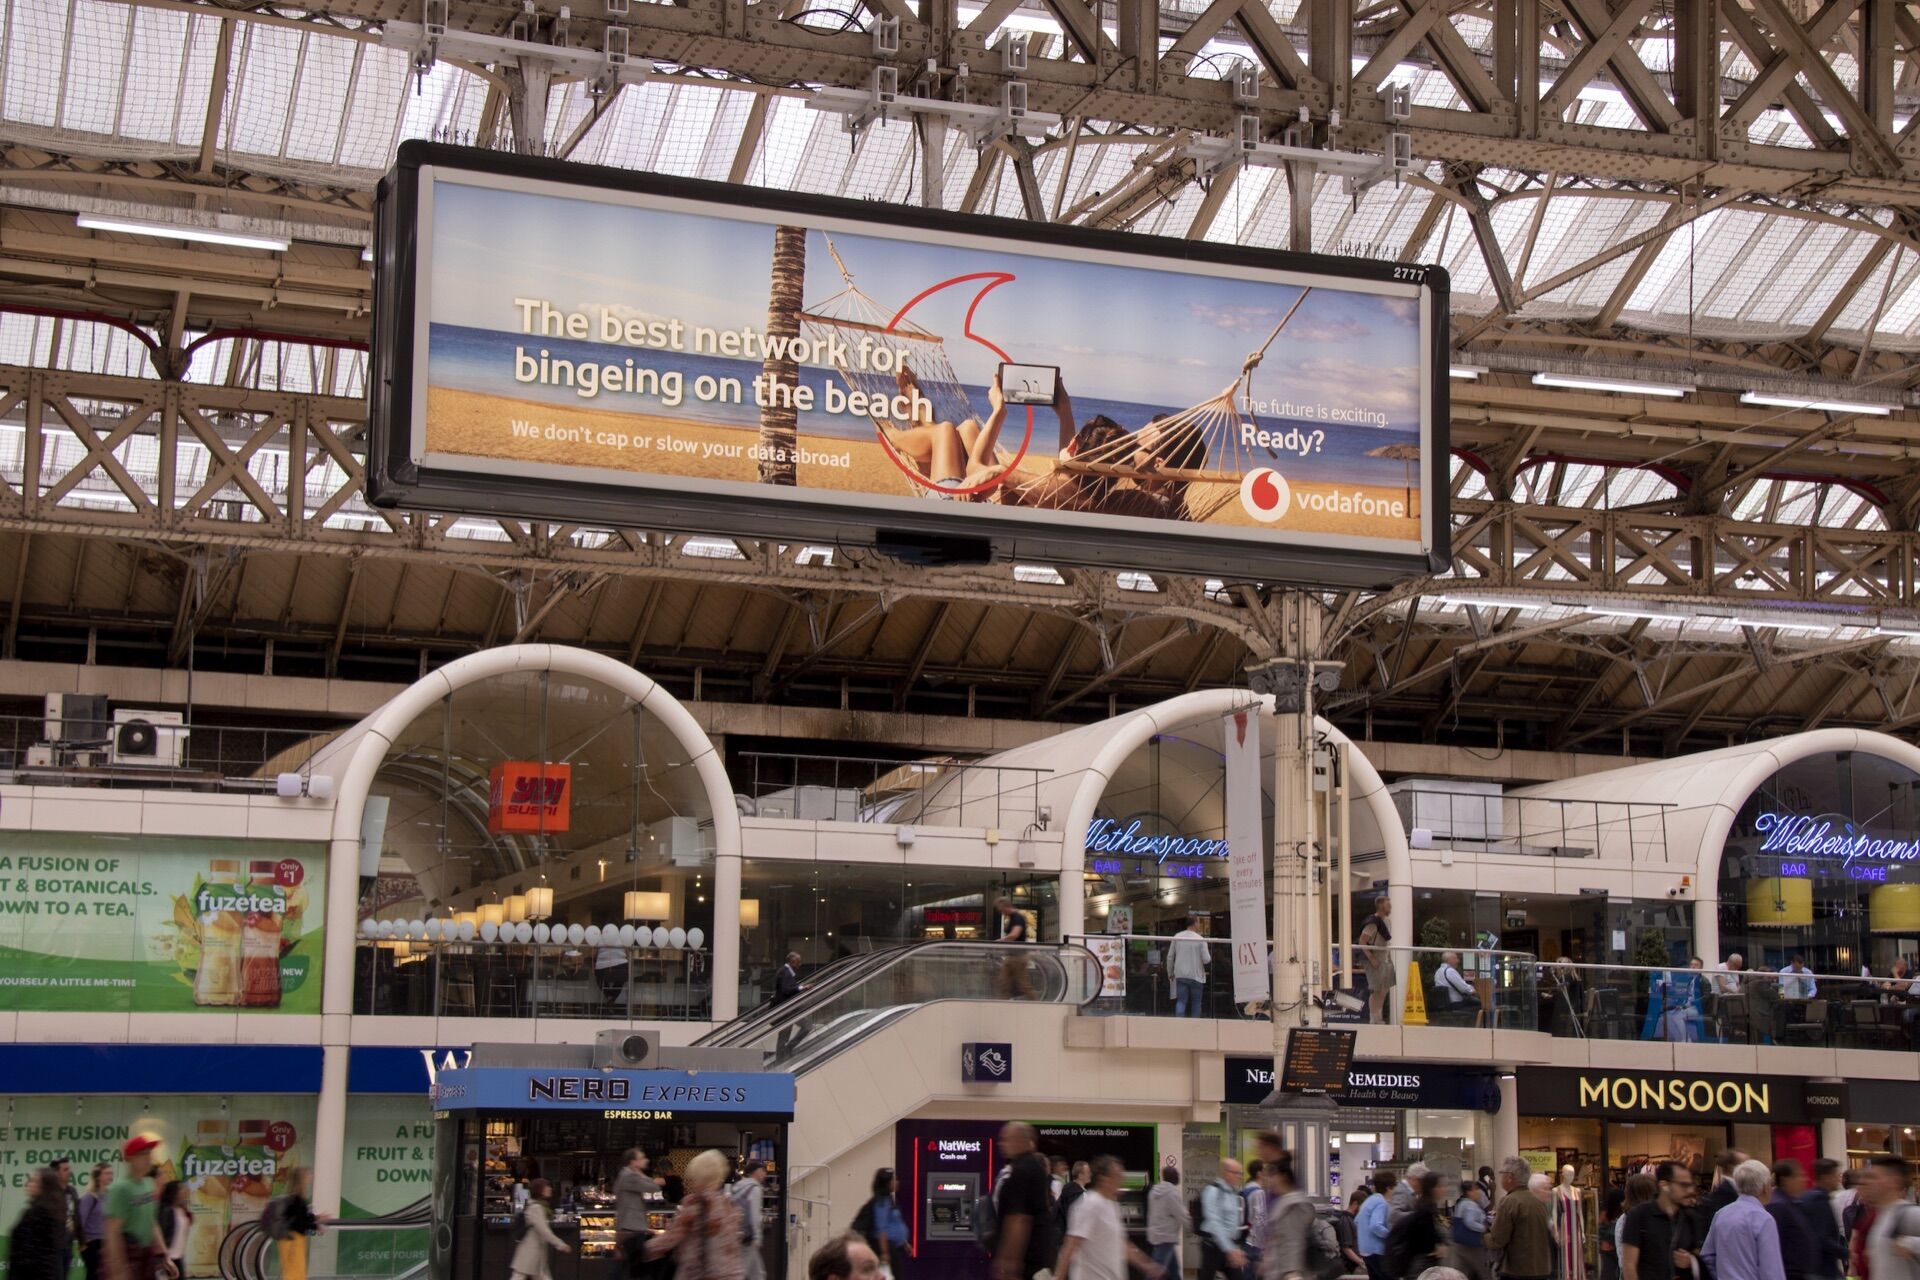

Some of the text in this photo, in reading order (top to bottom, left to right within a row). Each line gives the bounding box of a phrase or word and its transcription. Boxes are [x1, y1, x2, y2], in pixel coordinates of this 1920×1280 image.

[1394, 267, 1424, 281] 2777
[515, 298, 909, 373] The best network for
[515, 347, 933, 422] bingeing on the beach
[1240, 396, 1389, 428] The future is exciting.
[512, 420, 850, 468] We don't cap or slow your data abroad
[1241, 424, 1325, 456] Ready?
[1296, 491, 1404, 518] vodafone
[18, 857, 89, 871] FUSION
[95, 859, 120, 872] OF
[280, 863, 299, 872] Only
[1094, 860, 1121, 874] BAR
[1781, 863, 1807, 876] BAR
[284, 871, 295, 883] £1
[16, 879, 29, 892] &
[35, 879, 158, 896] BOTANICALS.
[44, 901, 70, 915] TO
[74, 902, 88, 915] A
[93, 902, 135, 916] TEA.
[199, 891, 286, 913] fuzetea
[282, 968, 304, 977] NEW
[50, 978, 58, 986] A
[60, 978, 92, 987] LITTLE
[93, 979, 136, 987] ME-TIME
[530, 1077, 747, 1103] NERO EXPRESS
[1349, 1089, 1376, 1099] Health
[1379, 1090, 1389, 1099] &
[1390, 1090, 1419, 1102] Beauty
[1579, 1076, 1769, 1114] MONSOON
[1807, 1095, 1840, 1106] MONSOON
[604, 1109, 673, 1120] ESPRESSO BAR
[14, 1127, 52, 1141] THE
[58, 1126, 129, 1141] FUSION
[272, 1126, 290, 1134] Only
[396, 1125, 408, 1138] A
[1040, 1127, 1070, 1135] welcome
[1079, 1127, 1104, 1136] Victoria
[1105, 1128, 1129, 1136] Station
[276, 1135, 286, 1147] £1
[939, 1140, 981, 1151] NatWest
[357, 1147, 407, 1160] FRUIT
[412, 1147, 424, 1160] &
[185, 1154, 276, 1177] fuzetea
[377, 1169, 432, 1182] DOWN
[358, 1250, 391, 1260] SERVE
